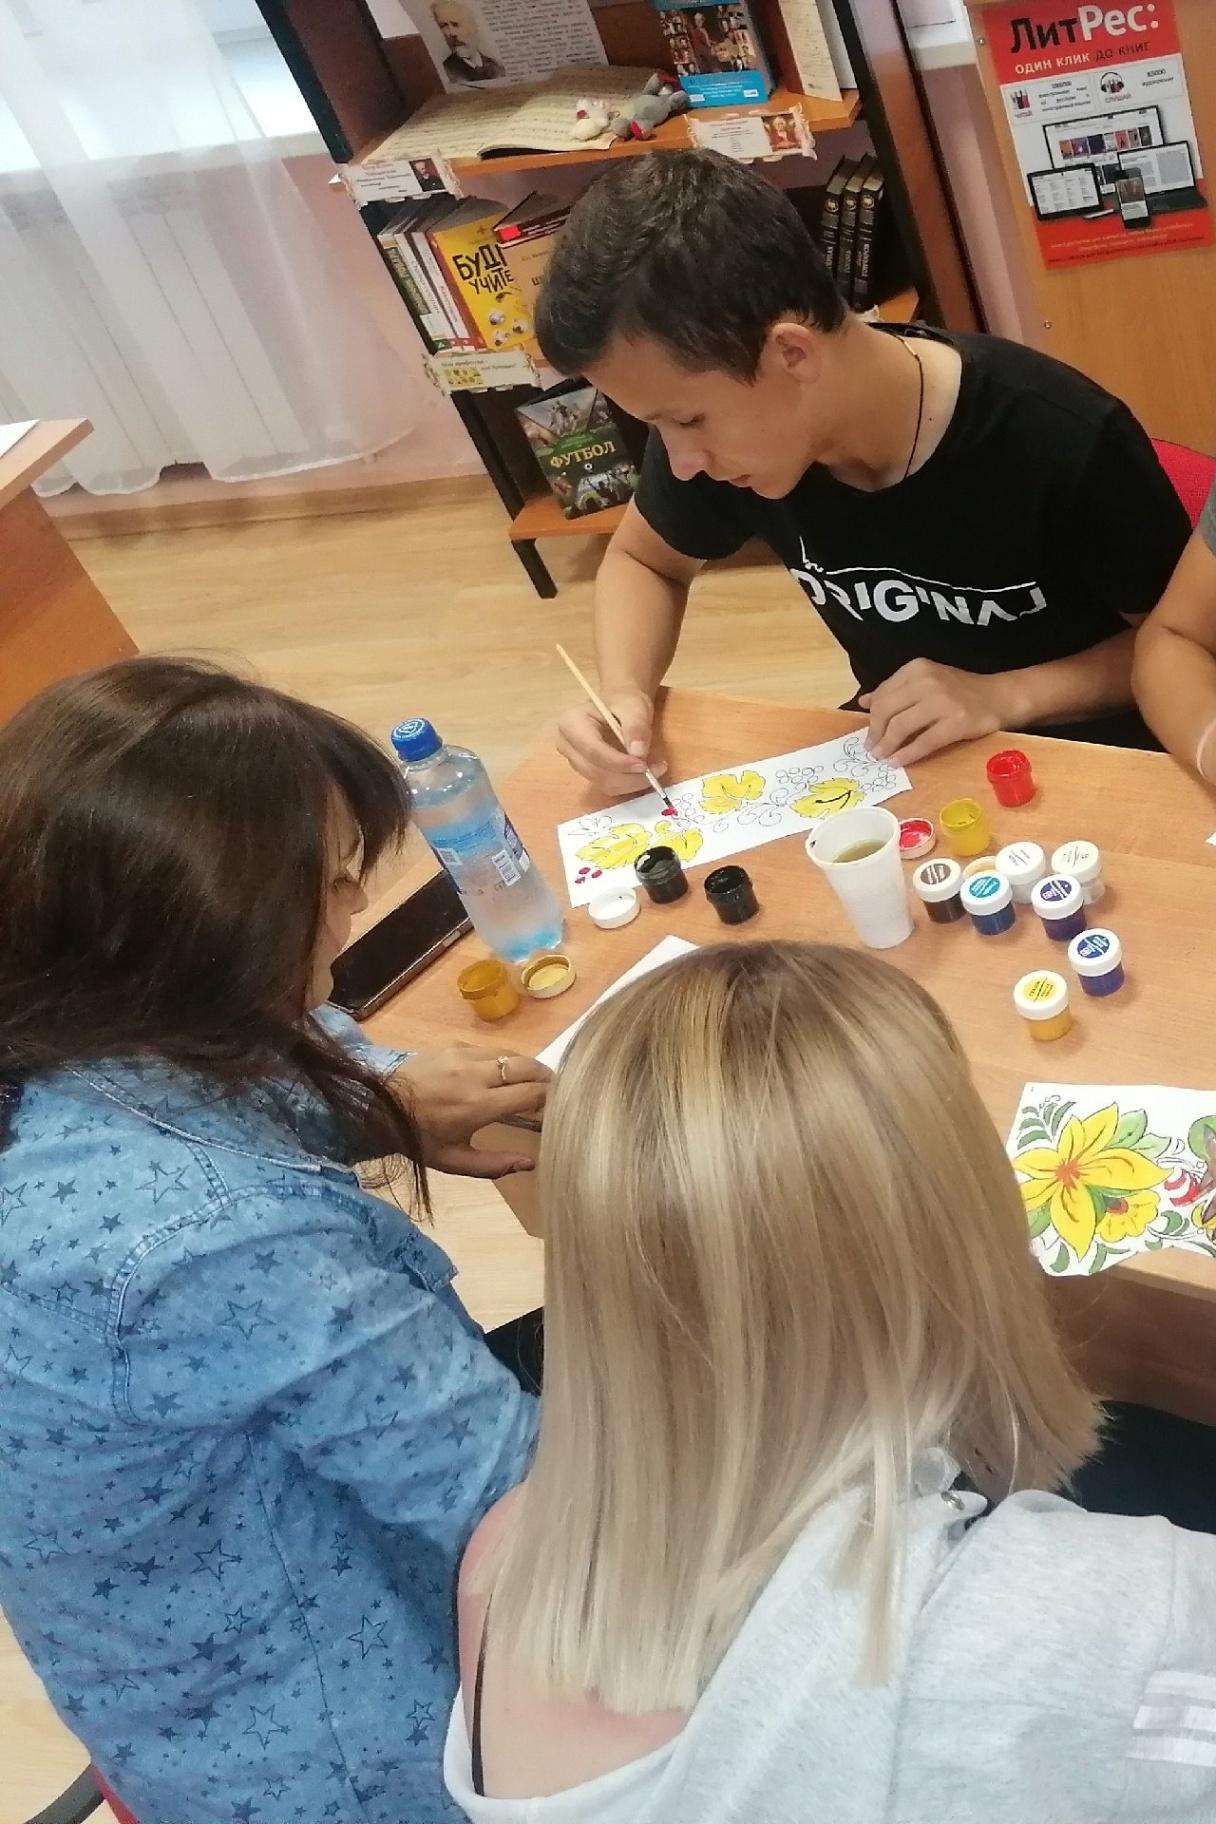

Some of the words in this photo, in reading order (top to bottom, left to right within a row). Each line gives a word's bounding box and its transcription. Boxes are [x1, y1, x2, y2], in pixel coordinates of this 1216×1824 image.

[1010, 3, 1159, 53] ЛитРес:
[468, 267, 515, 295] УЧИТЕ
[550, 440, 617, 469] ФУТБОЛ
